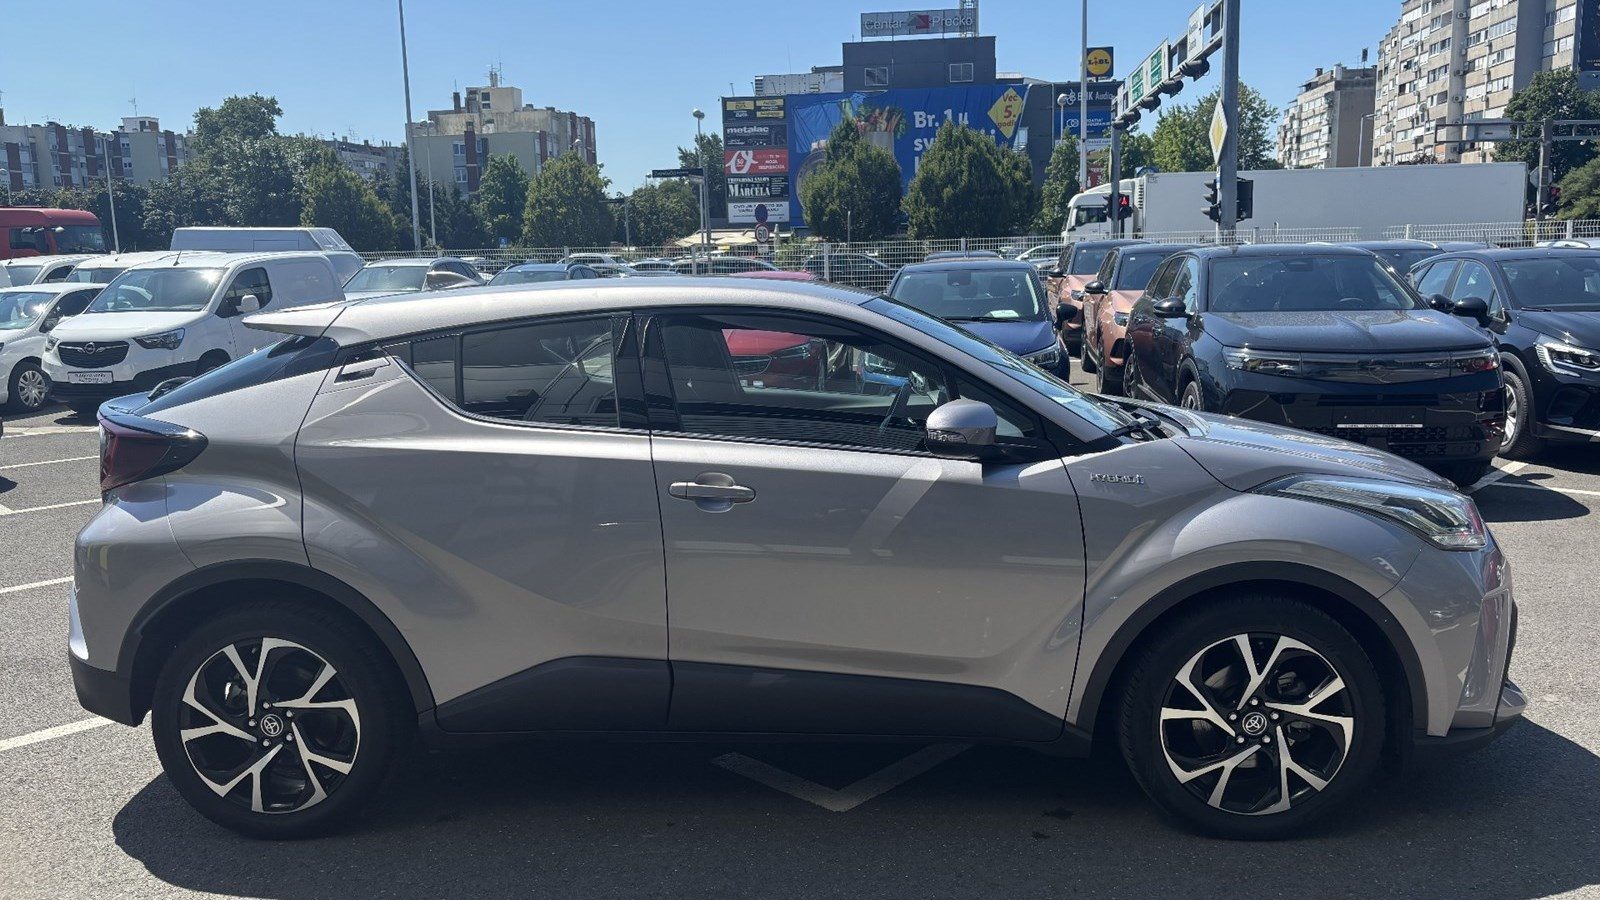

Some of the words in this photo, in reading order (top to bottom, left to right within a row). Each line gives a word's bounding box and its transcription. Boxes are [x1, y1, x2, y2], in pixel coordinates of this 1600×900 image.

[864, 19, 904, 30] Centar
[914, 111, 939, 128] Br.
[727, 126, 769, 134] metalac
[728, 184, 770, 197] MARCELA
[758, 229, 767, 239] 60
